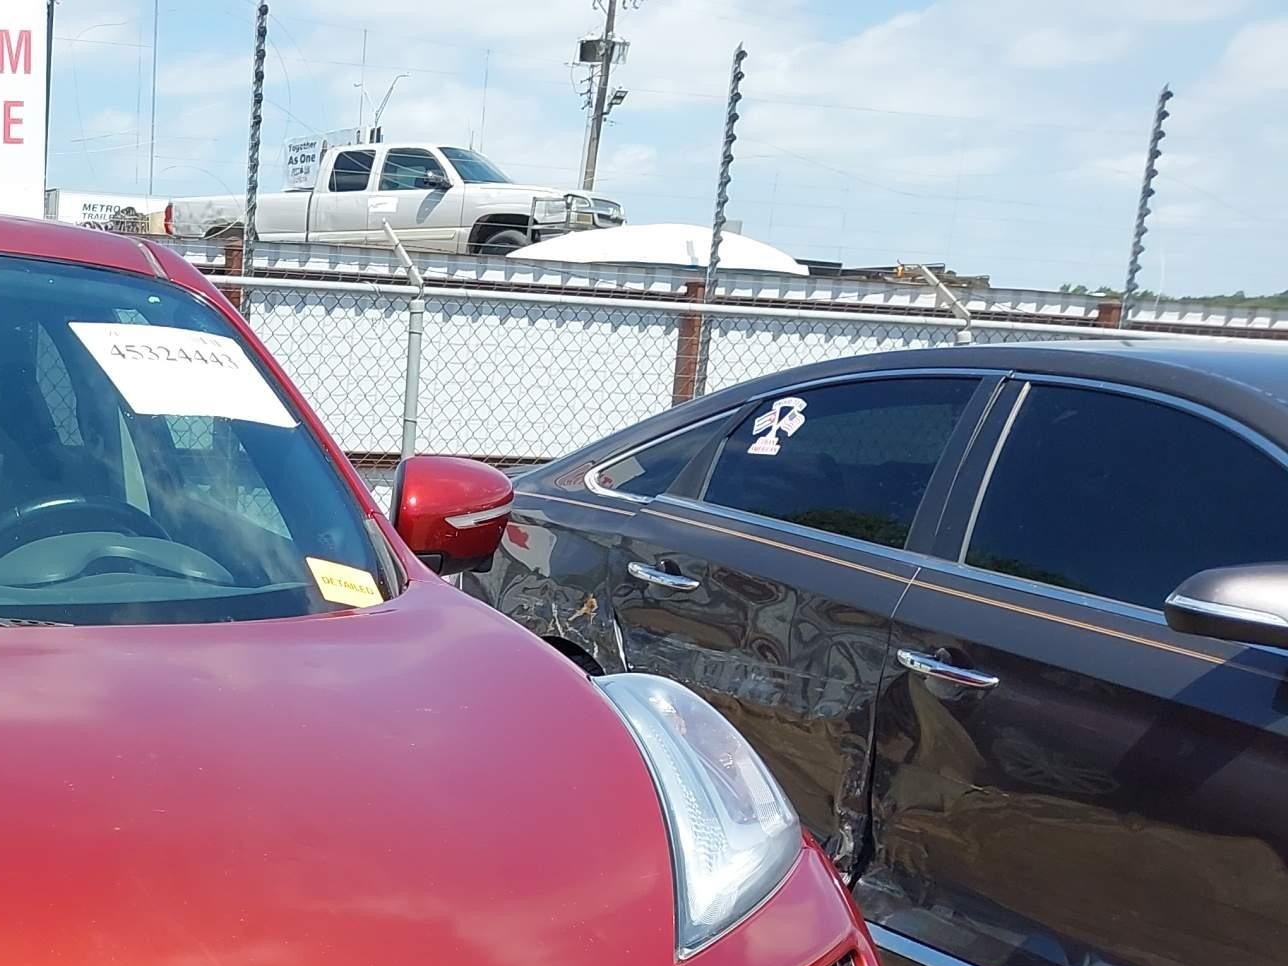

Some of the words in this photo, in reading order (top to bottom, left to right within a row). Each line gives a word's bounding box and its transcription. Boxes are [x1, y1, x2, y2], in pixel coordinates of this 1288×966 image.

[288, 155, 298, 165] As
[300, 153, 316, 164] One
[82, 203, 121, 213] METRO
[110, 344, 240, 369] 45324443
